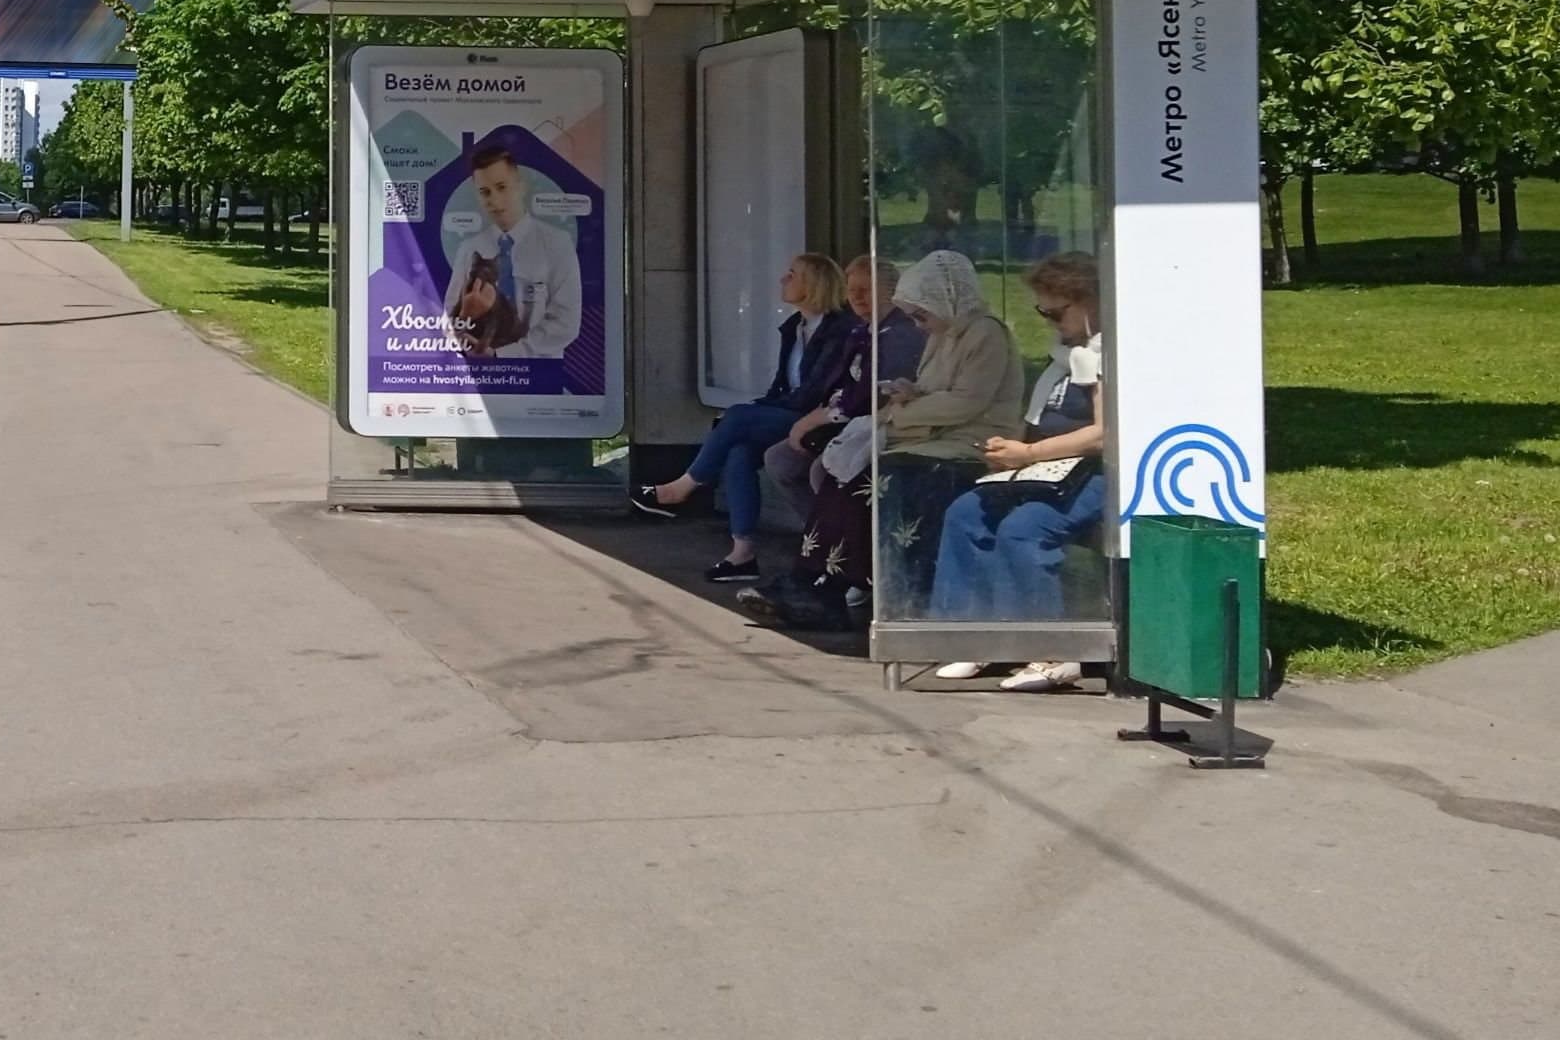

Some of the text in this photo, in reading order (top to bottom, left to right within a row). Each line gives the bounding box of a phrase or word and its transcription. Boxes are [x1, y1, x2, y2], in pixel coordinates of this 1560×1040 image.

[1192, 16, 1208, 72] Metro
[384, 73, 526, 94] Везём домой
[1160, 85, 1188, 184] Метро
[381, 303, 476, 330] Хвосты
[386, 336, 472, 352] и лапки
[383, 361, 530, 373] Посмотреть анкеты животных
[383, 374, 530, 386] можно на hvostyilapki.wi-fi.ru
